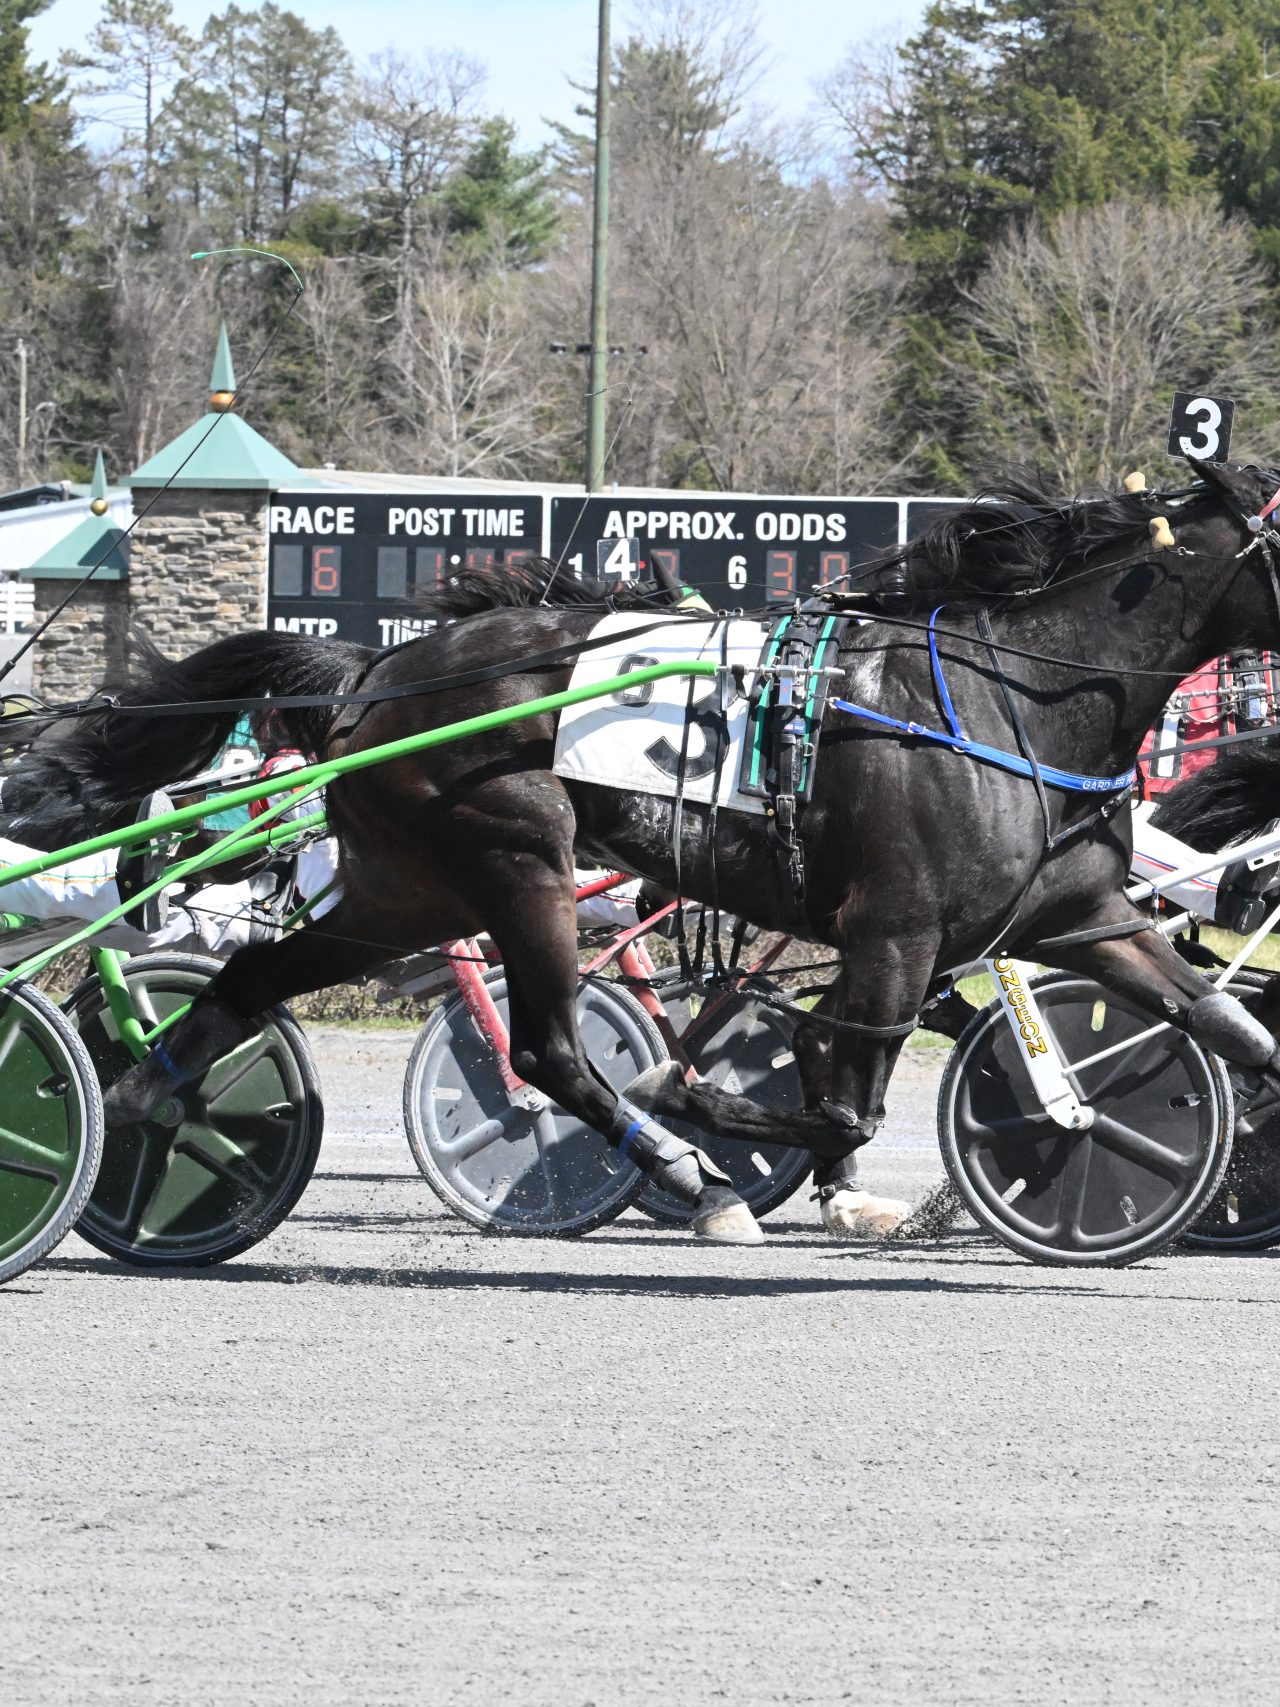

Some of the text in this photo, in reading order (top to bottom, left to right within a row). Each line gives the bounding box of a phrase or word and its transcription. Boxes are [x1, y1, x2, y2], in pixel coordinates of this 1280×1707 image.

[1179, 397, 1222, 460] 3
[269, 506, 355, 535] RACE
[388, 507, 525, 537] POST TIME
[602, 510, 847, 542] APPROX. ODDS
[313, 548, 338, 591] 6
[604, 538, 637, 581] 4
[727, 555, 748, 590] 6
[993, 958, 1048, 1058] ONGEON
